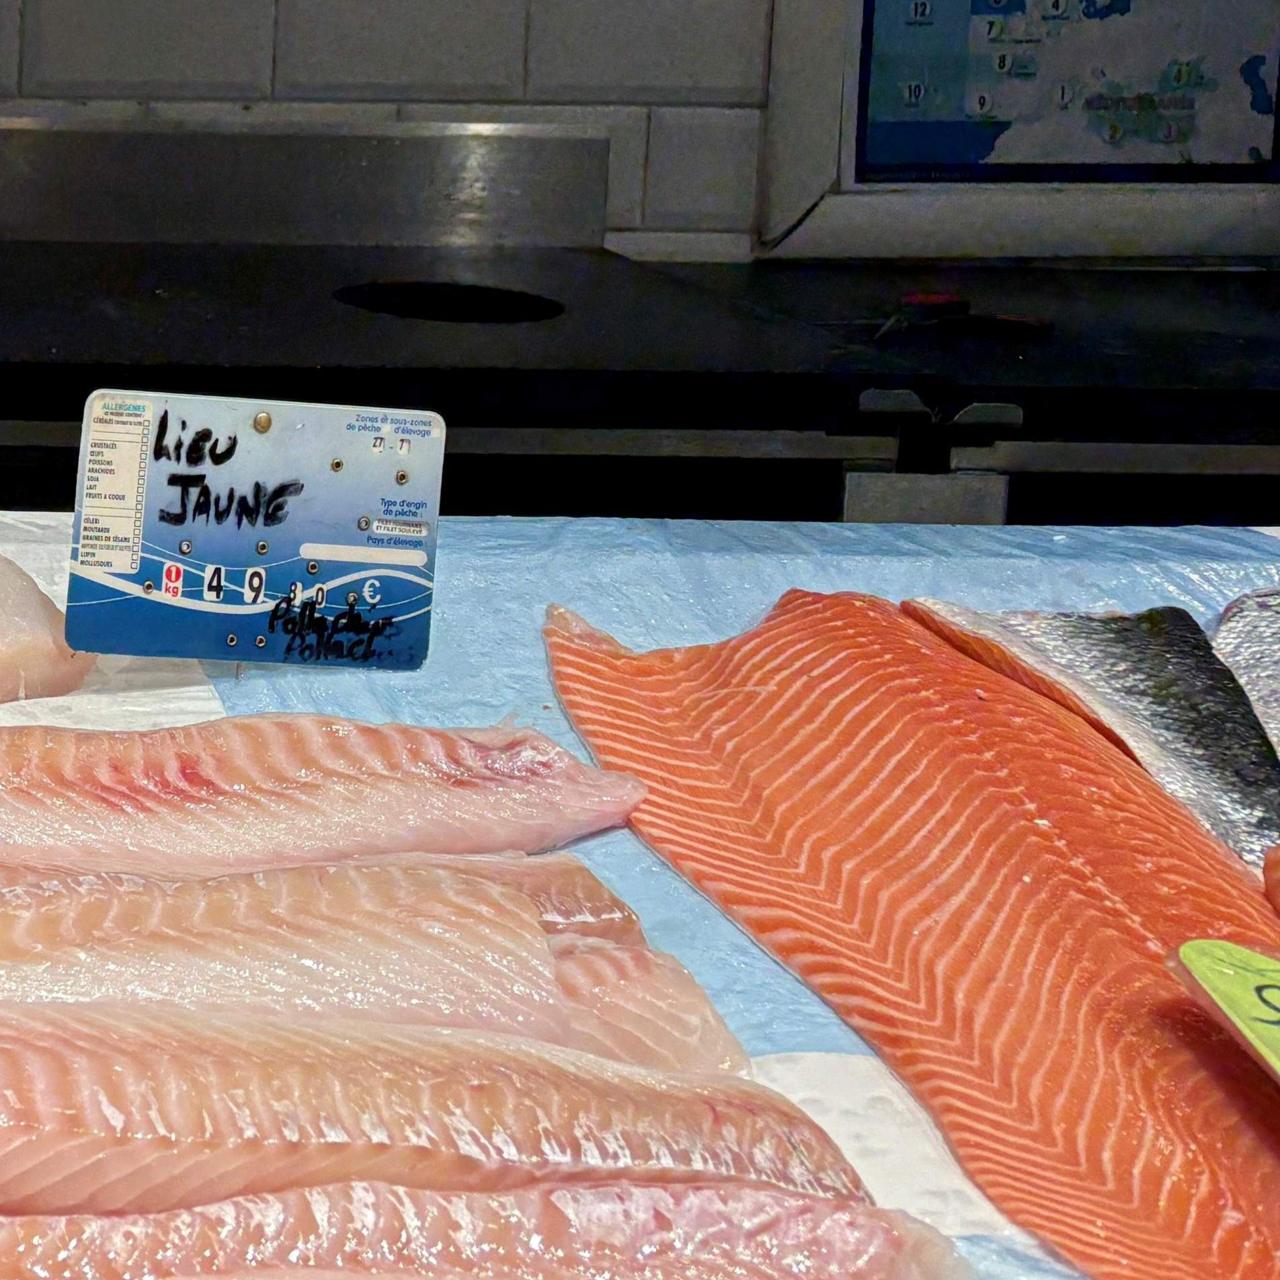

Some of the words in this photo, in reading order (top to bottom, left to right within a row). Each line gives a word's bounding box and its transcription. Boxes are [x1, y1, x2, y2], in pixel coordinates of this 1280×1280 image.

[355, 413, 379, 425] Zones
[346, 422, 357, 432] de
[358, 423, 382, 435] pêche
[380, 497, 398, 512] Type
[398, 498, 428, 514] d'engin
[382, 508, 393, 518] de
[394, 508, 418, 520] pêche
[366, 534, 386, 549] Pays
[387, 535, 424, 551] d'élevage
[164, 582, 180, 598] kg
[361, 580, 385, 606] €
